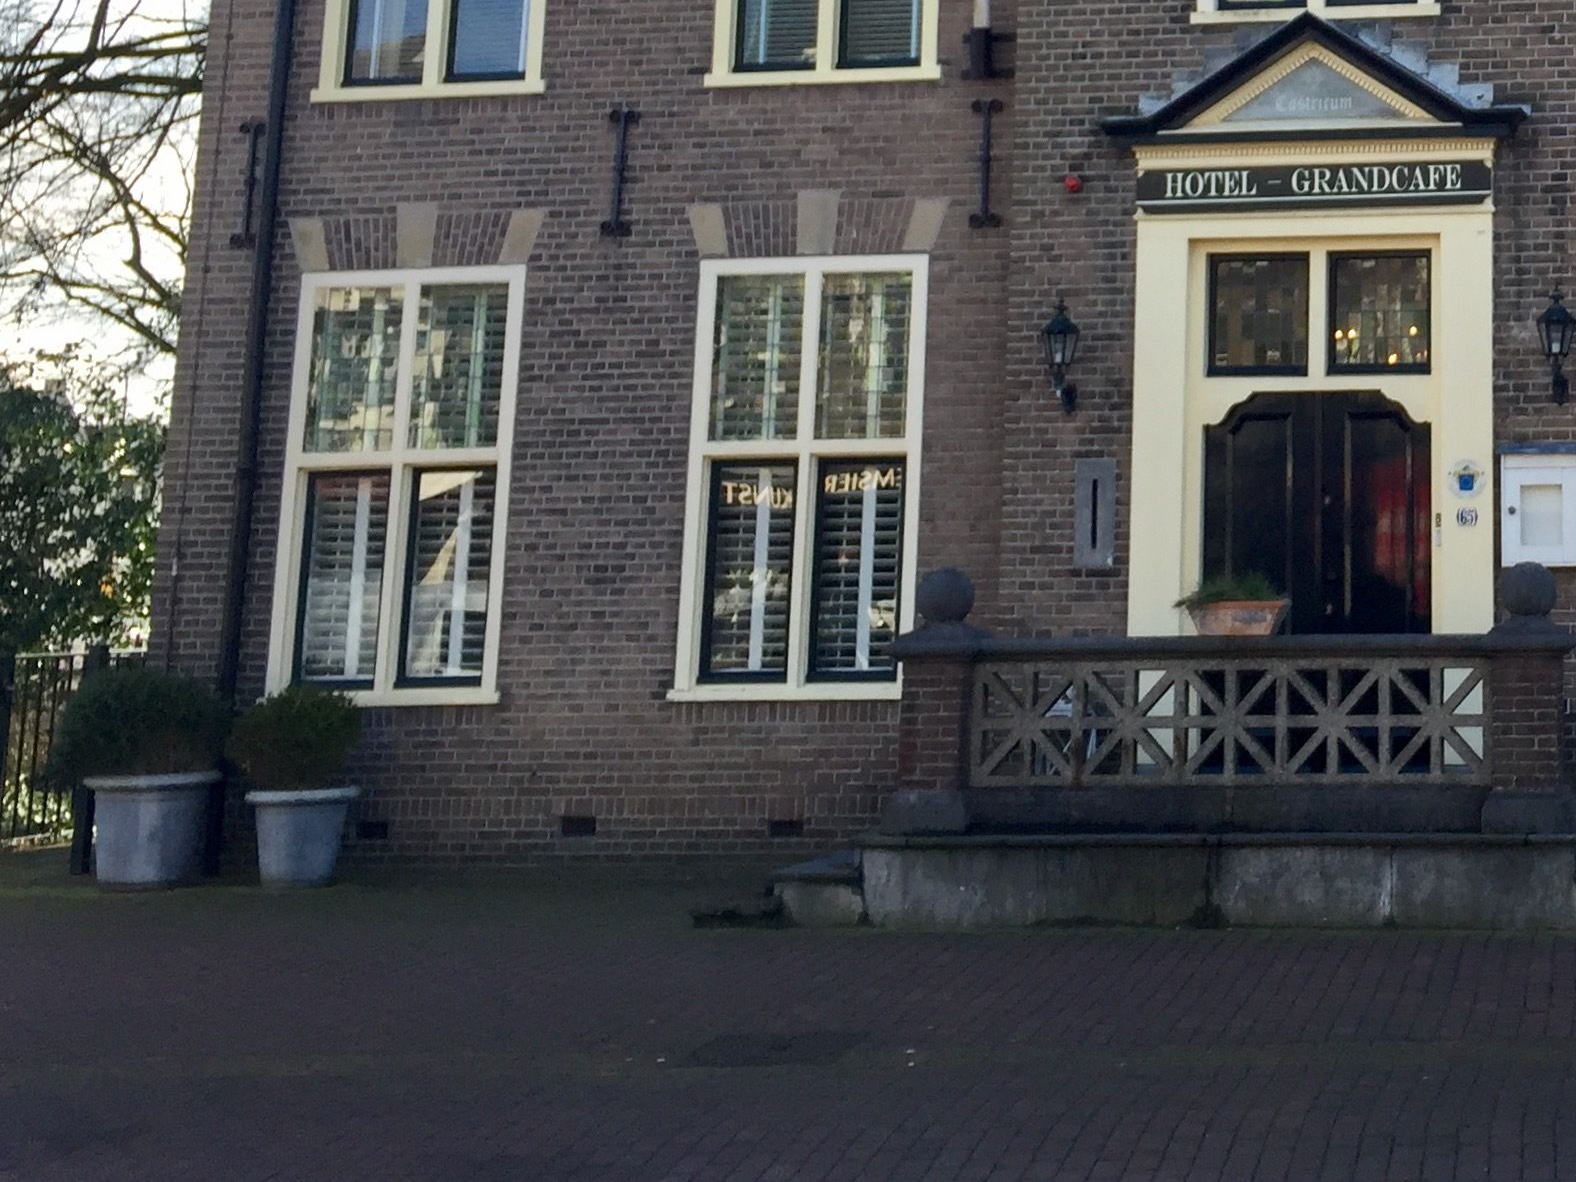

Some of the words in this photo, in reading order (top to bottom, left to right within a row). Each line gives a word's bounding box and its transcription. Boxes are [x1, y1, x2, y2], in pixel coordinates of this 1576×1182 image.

[1164, 170, 1258, 199] HOTEL
[1291, 163, 1462, 195] GRANDCAFE
[1460, 508, 1475, 526] 65
